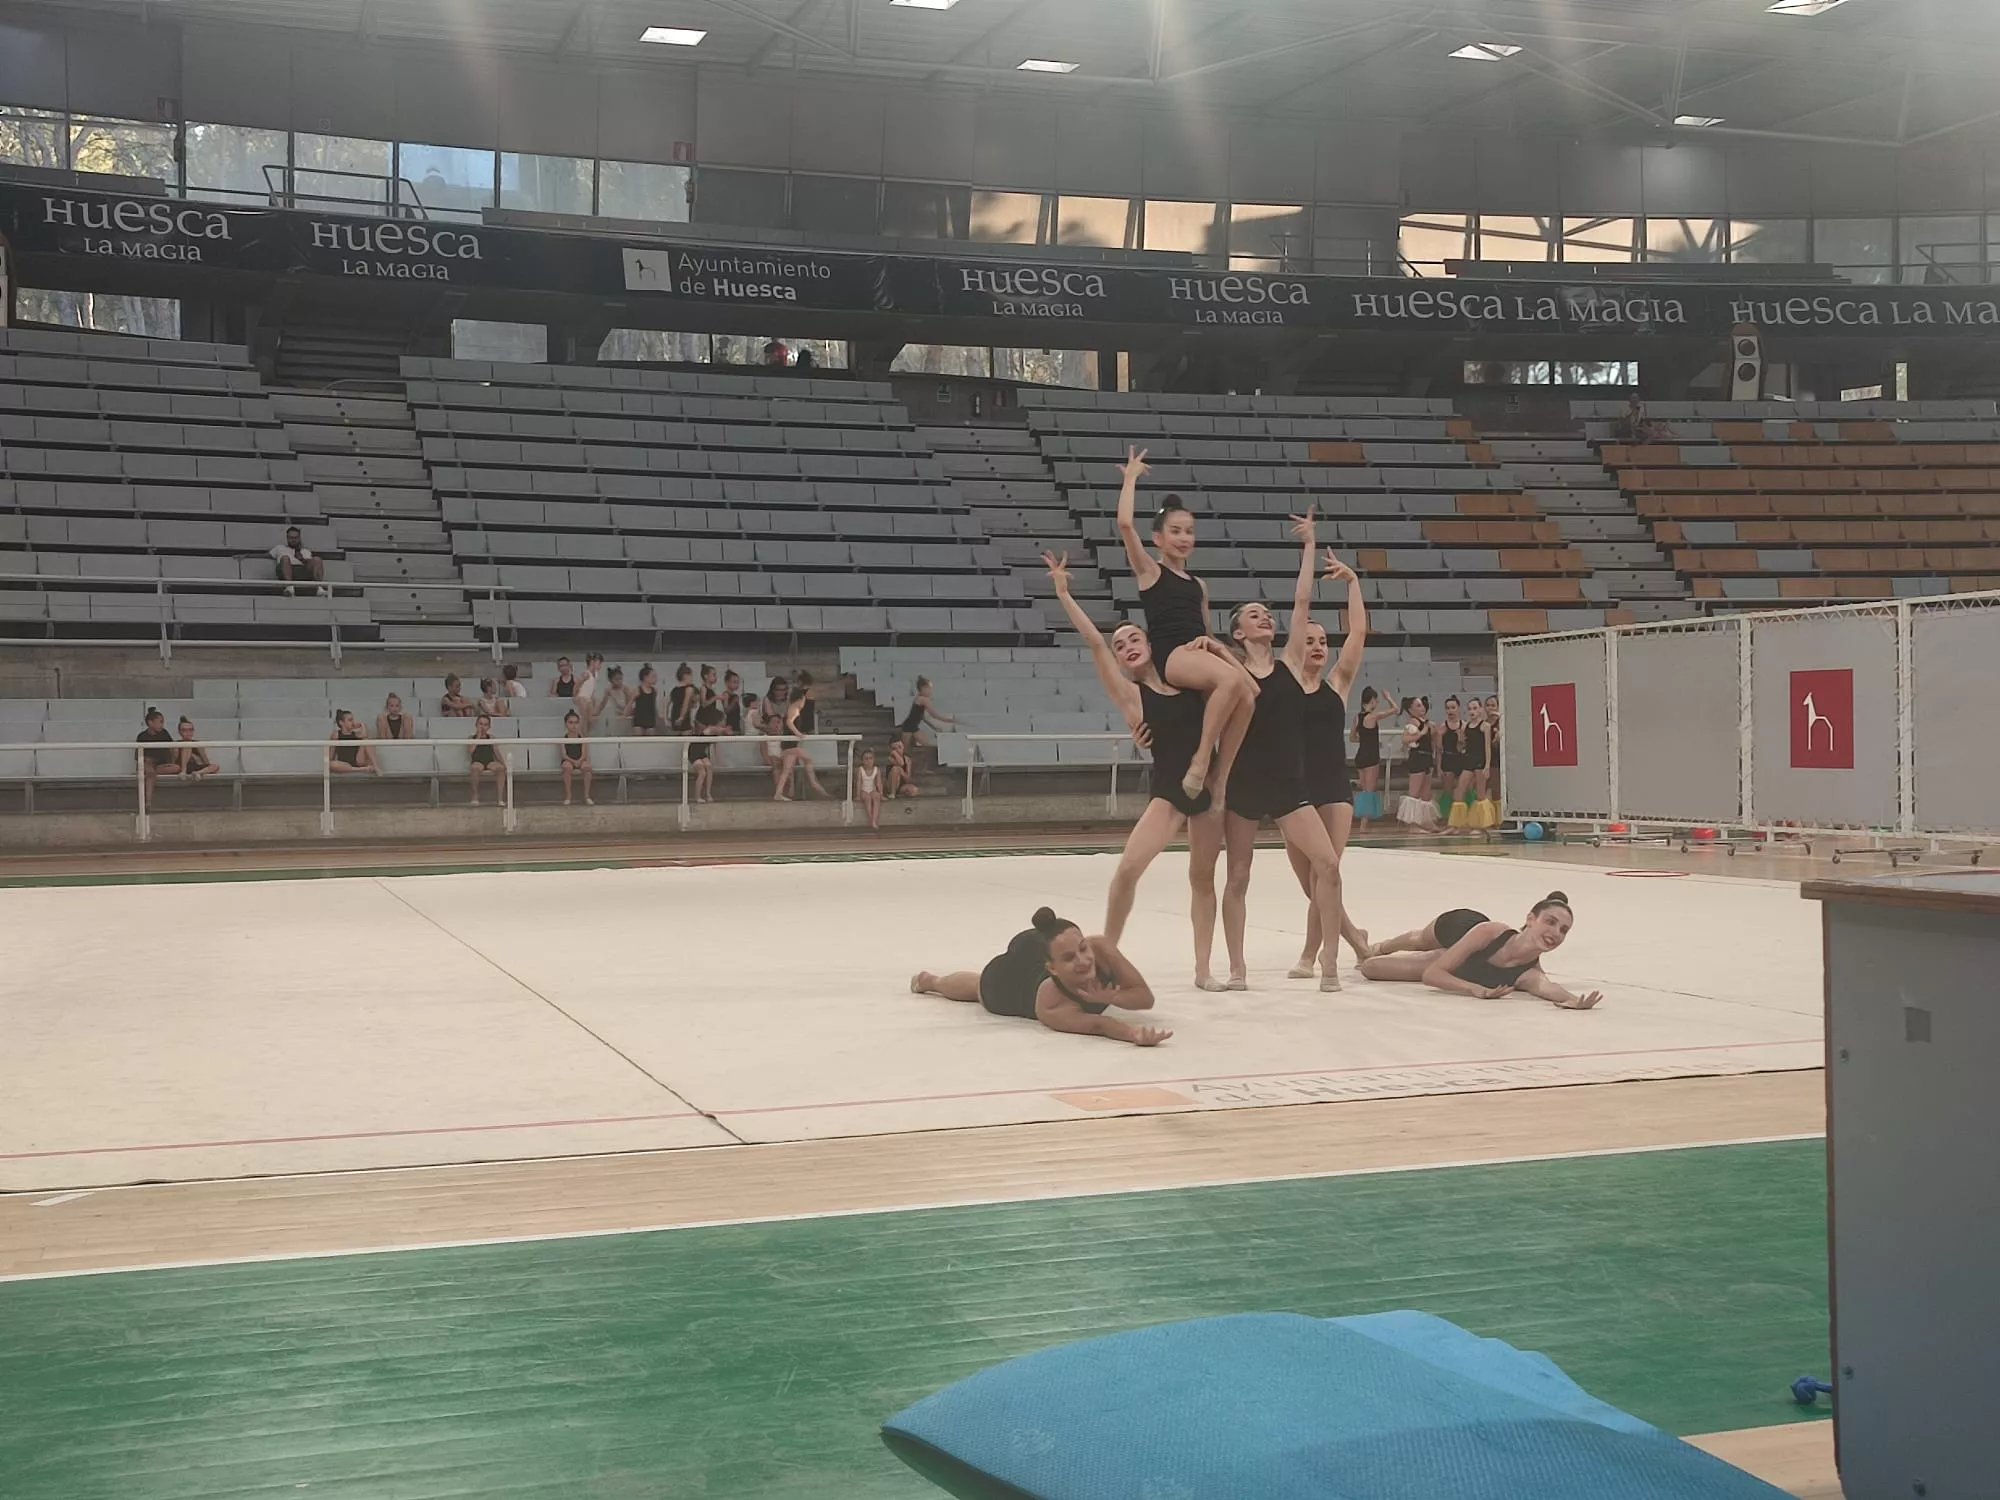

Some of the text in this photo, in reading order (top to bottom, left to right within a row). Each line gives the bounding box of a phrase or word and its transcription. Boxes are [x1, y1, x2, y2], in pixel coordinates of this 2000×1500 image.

[43, 197, 232, 241] Huesca
[84, 237, 113, 256] La
[311, 221, 483, 259] Huesca
[343, 259, 369, 276] La
[677, 253, 832, 280] Ayuntamiento
[680, 277, 797, 301] de Huesca
[961, 267, 1107, 298] Huesca
[1168, 276, 1311, 305] Huesca
[993, 301, 1015, 316] La
[1195, 309, 1218, 323] La
[1352, 289, 1505, 320] Huesca
[1516, 296, 1560, 320] La
[1731, 297, 1881, 325] Huesca
[1889, 300, 1936, 325] La
